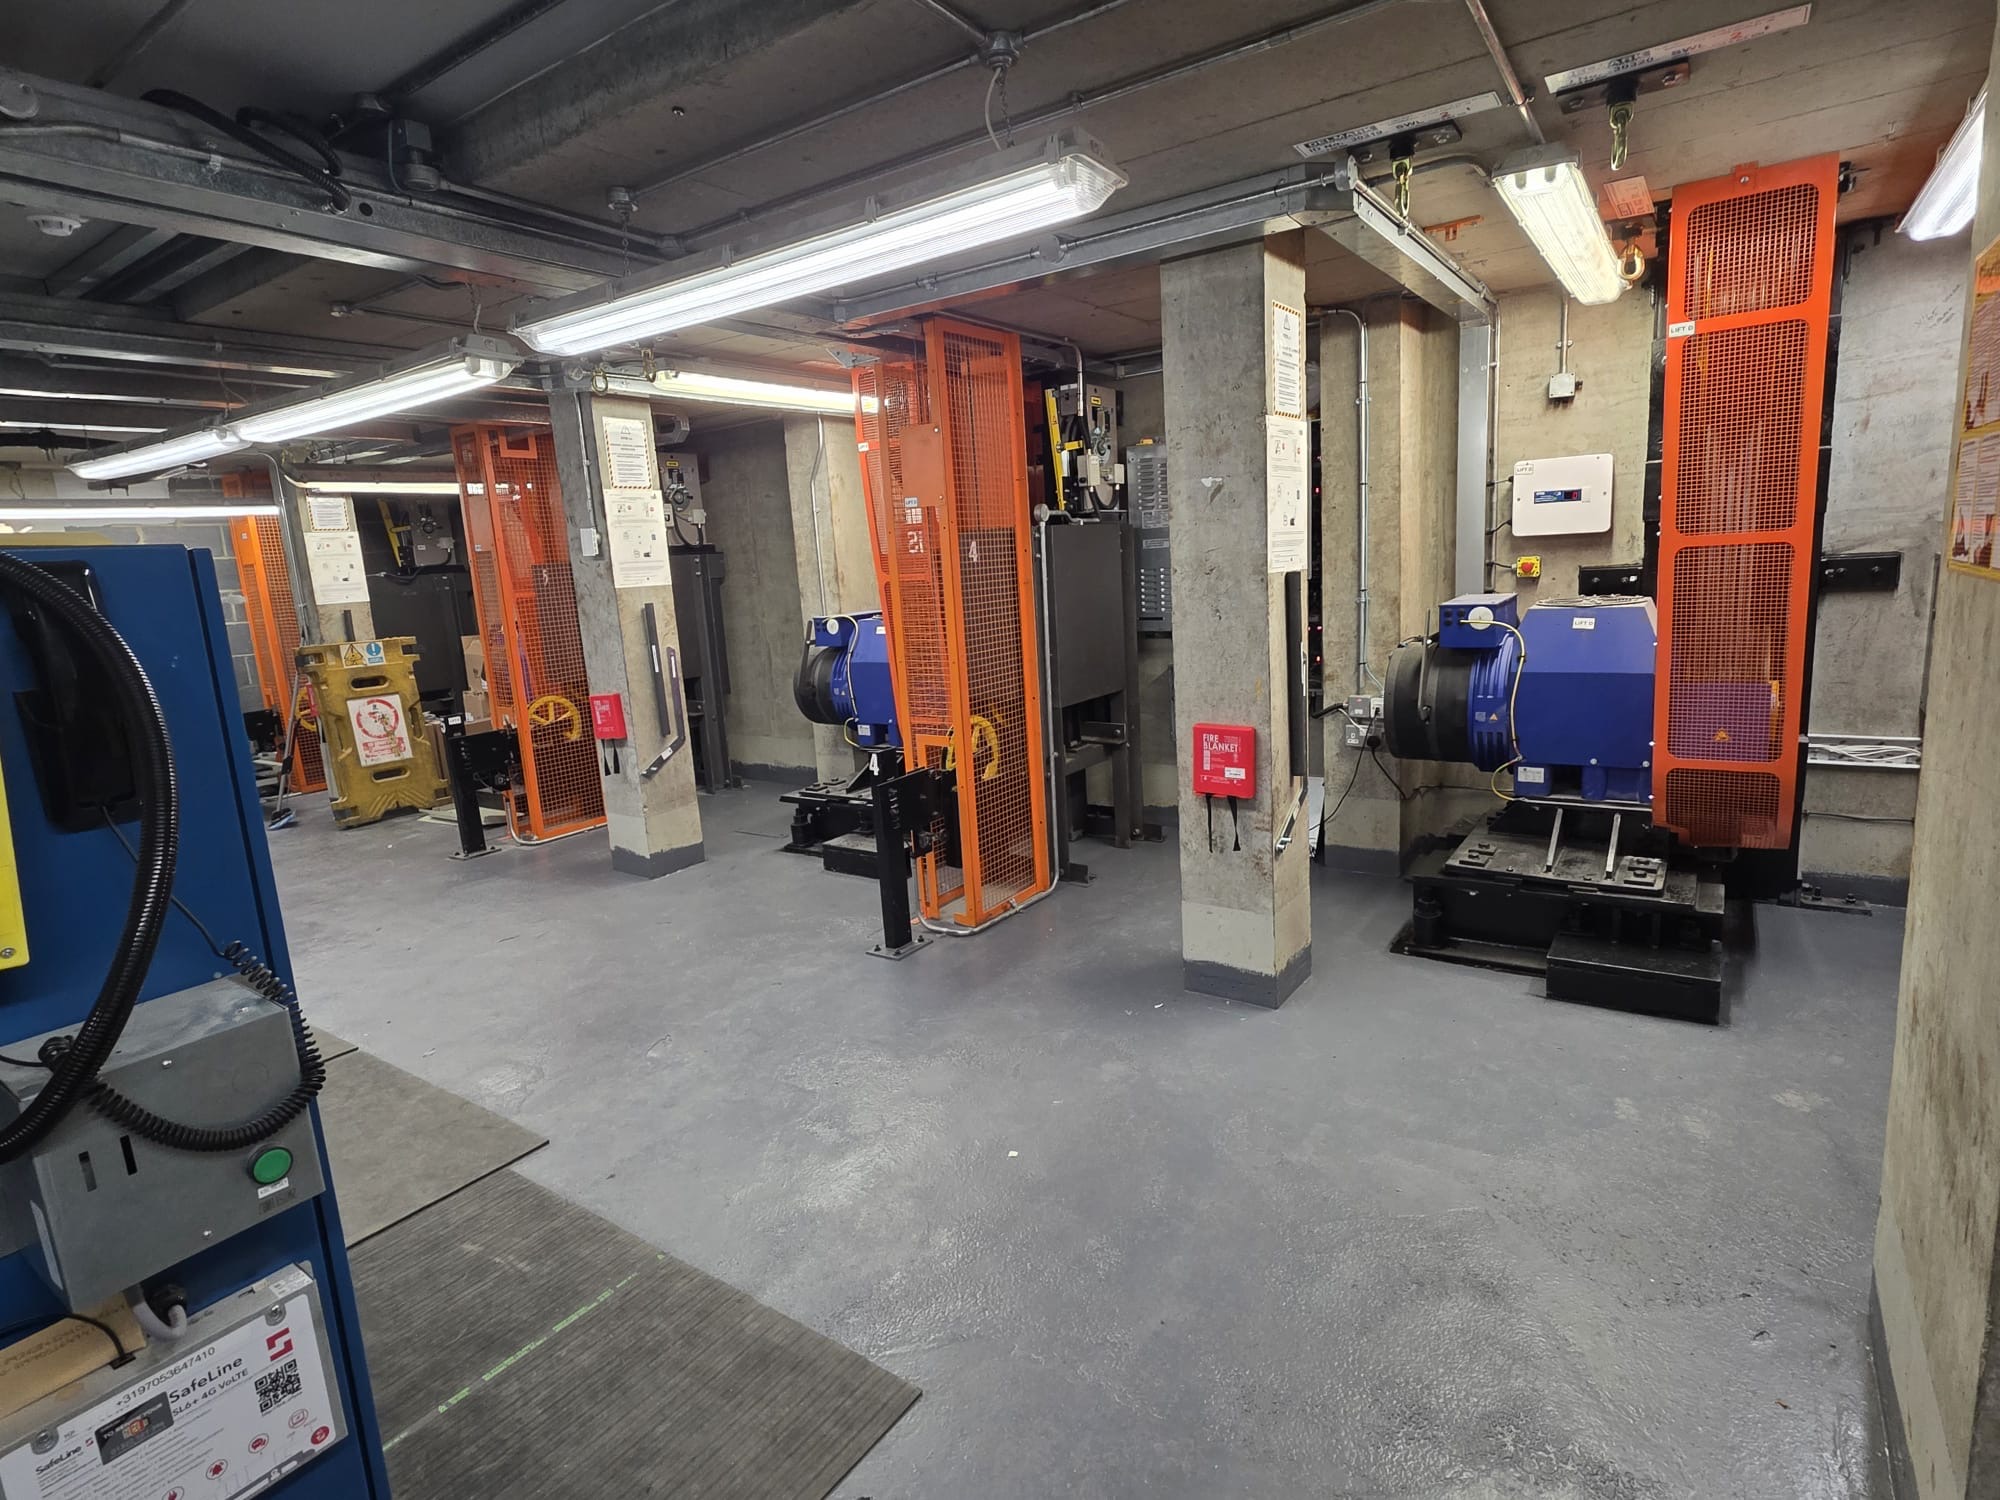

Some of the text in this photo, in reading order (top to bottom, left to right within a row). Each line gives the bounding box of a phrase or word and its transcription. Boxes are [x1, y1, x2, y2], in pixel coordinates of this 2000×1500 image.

[1670, 326, 1686, 334] LIFT
[968, 541, 978, 562] 4
[1203, 733, 1219, 743] FIRE
[1203, 742, 1238, 753] BLANKET
[869, 753, 880, 776] 4
[169, 1357, 243, 1404] SafeLine
[172, 1368, 249, 1417] SL6+ 4G VoLTE
[36, 1446, 82, 1473] SafeLine
